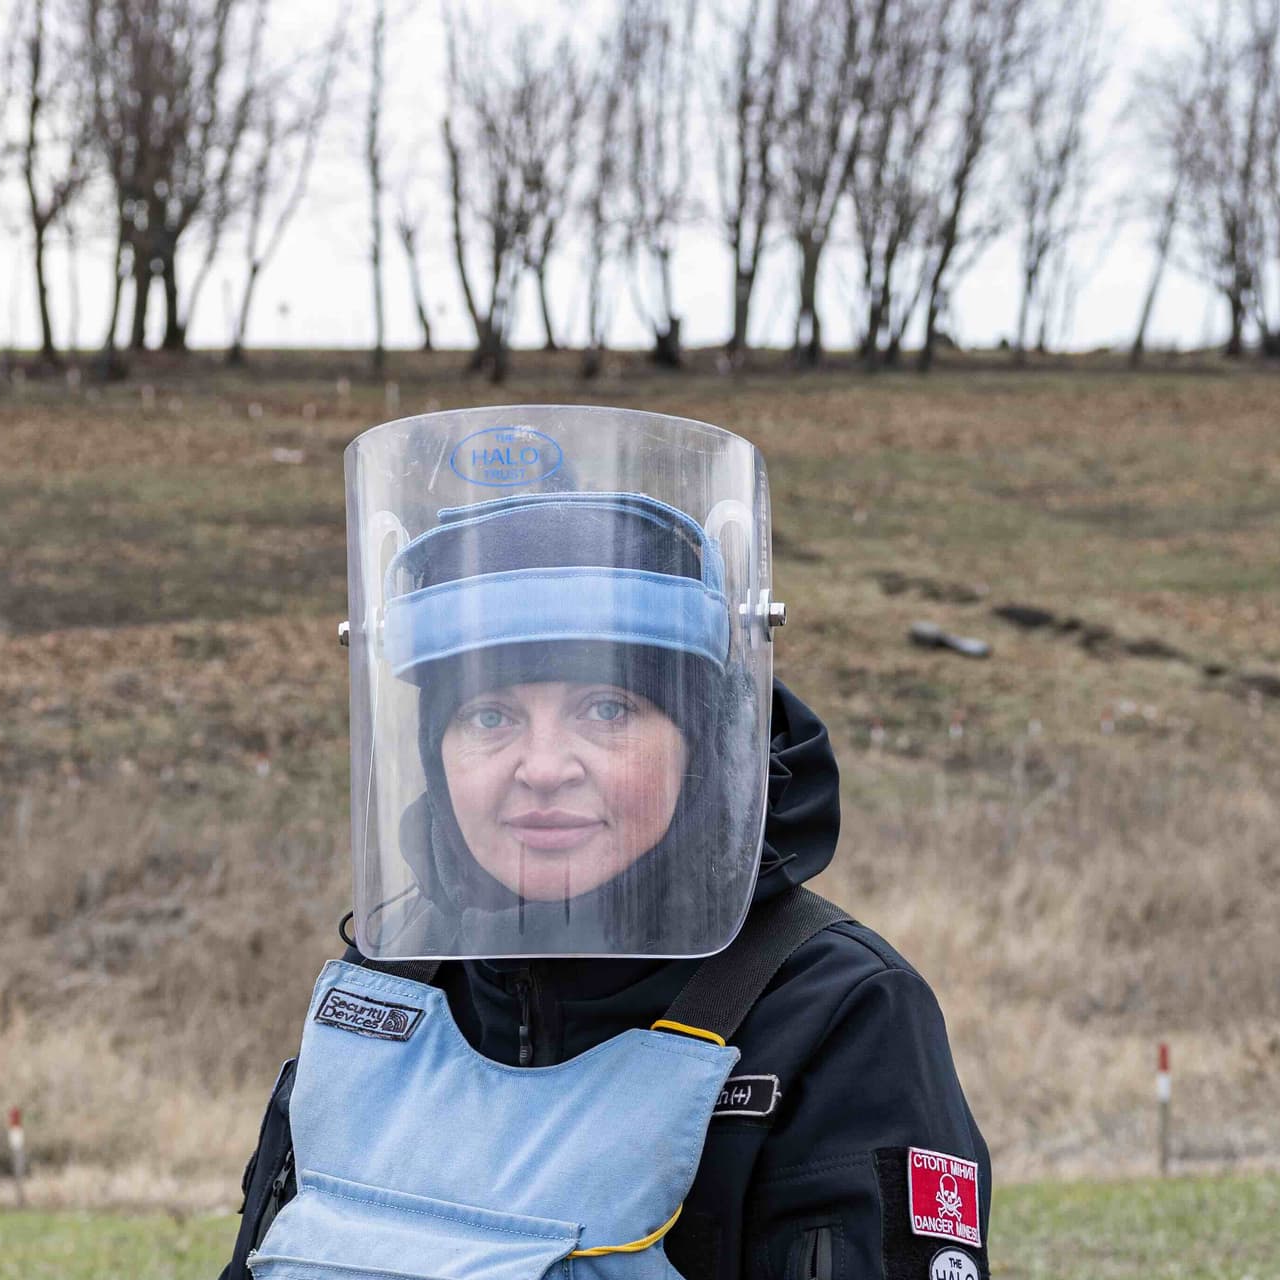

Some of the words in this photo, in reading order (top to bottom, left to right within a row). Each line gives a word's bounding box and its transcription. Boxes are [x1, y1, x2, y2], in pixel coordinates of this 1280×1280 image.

[472, 447, 540, 465] HALO
[484, 468, 526, 480] TRUST
[322, 1005, 379, 1029] Devices
[329, 995, 387, 1023] Security
[915, 1215, 955, 1234] DANGER
[949, 1257, 962, 1269] THE
